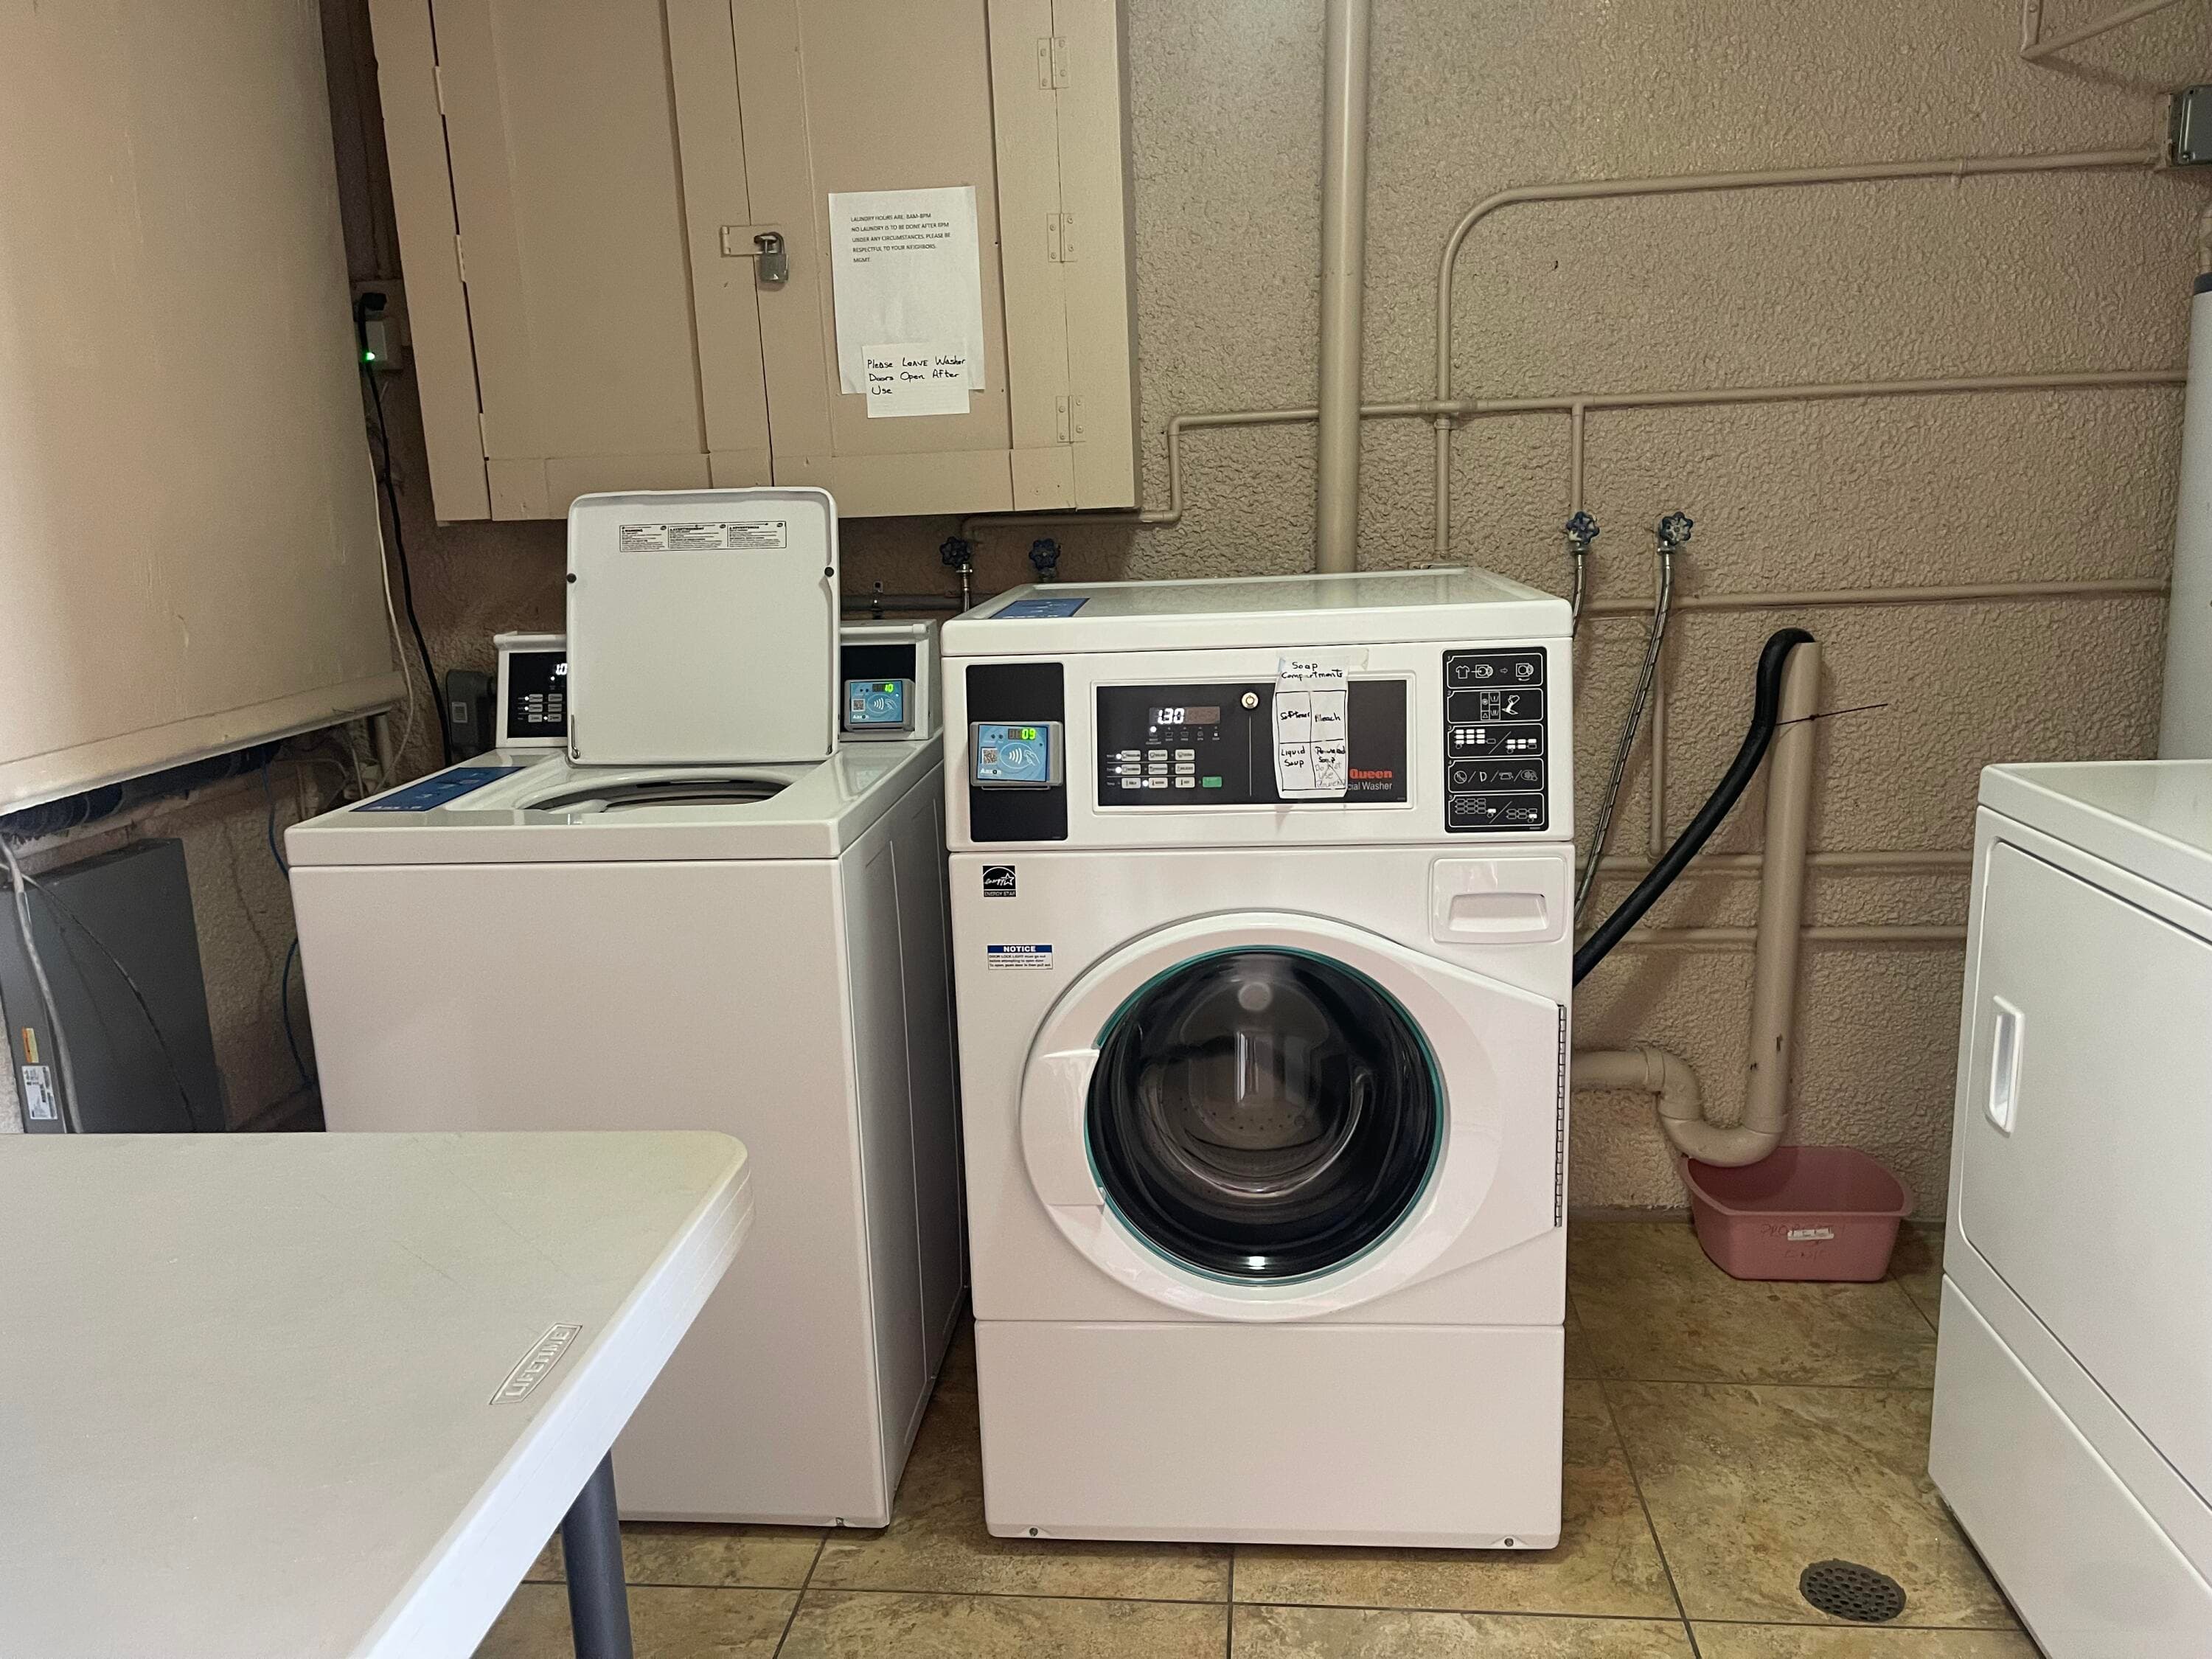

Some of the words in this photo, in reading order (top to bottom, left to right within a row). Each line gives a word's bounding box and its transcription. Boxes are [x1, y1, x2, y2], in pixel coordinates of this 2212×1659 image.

[935, 355, 966, 366] Washer
[869, 373, 894, 381] Doors
[900, 372, 925, 383] Open
[872, 385, 893, 395] Use
[1292, 661, 1318, 671] Soap
[1281, 745, 1305, 757] Liquid
[1349, 768, 1393, 779] Queen
[1362, 782, 1393, 790] Washer
[504, 1331, 570, 1397] LIFETIME
